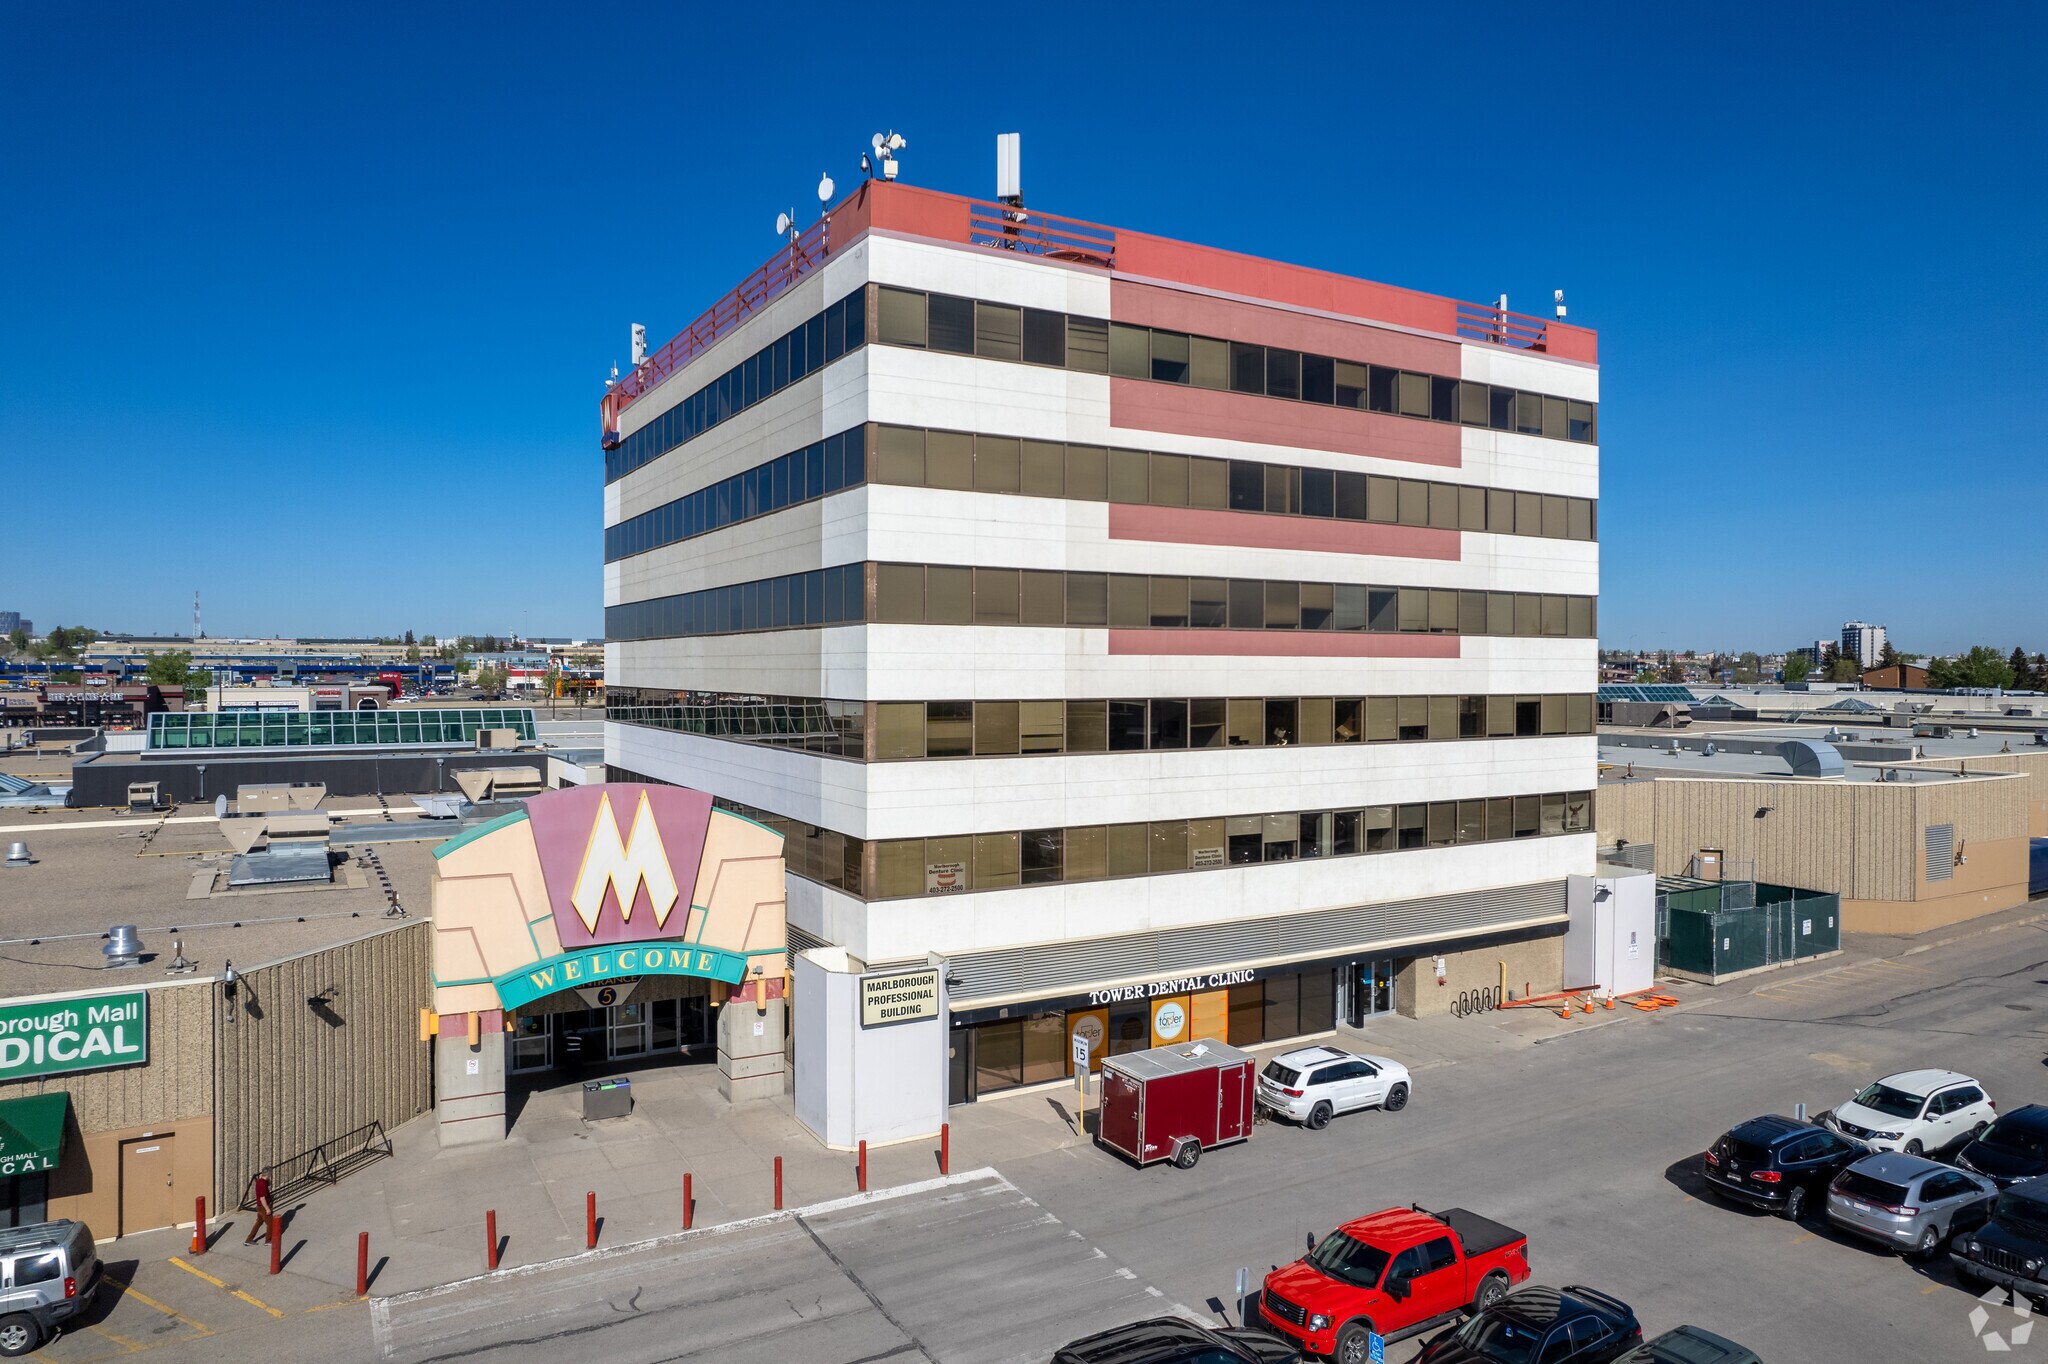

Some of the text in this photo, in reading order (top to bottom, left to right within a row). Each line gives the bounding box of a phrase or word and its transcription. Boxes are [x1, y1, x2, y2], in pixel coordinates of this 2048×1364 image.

[570, 789, 679, 937] M
[929, 885, 963, 893] 403-272-2500
[530, 950, 713, 990] WELCOME
[576, 975, 638, 988] NTRANCE
[867, 975, 934, 992] MARLBOROUGH
[1089, 969, 1255, 1005] TOWER DENTAL CLINIC
[602, 989, 612, 1004] 5
[868, 989, 934, 1006] PROFESSIONAL
[88, 1002, 137, 1024] Mall
[880, 1004, 922, 1018] BUILDING
[0, 1025, 139, 1069] DICAL
[1075, 1046, 1086, 1061] 15
[16, 1152, 39, 1160] MALL
[2, 1157, 53, 1174] CAL
